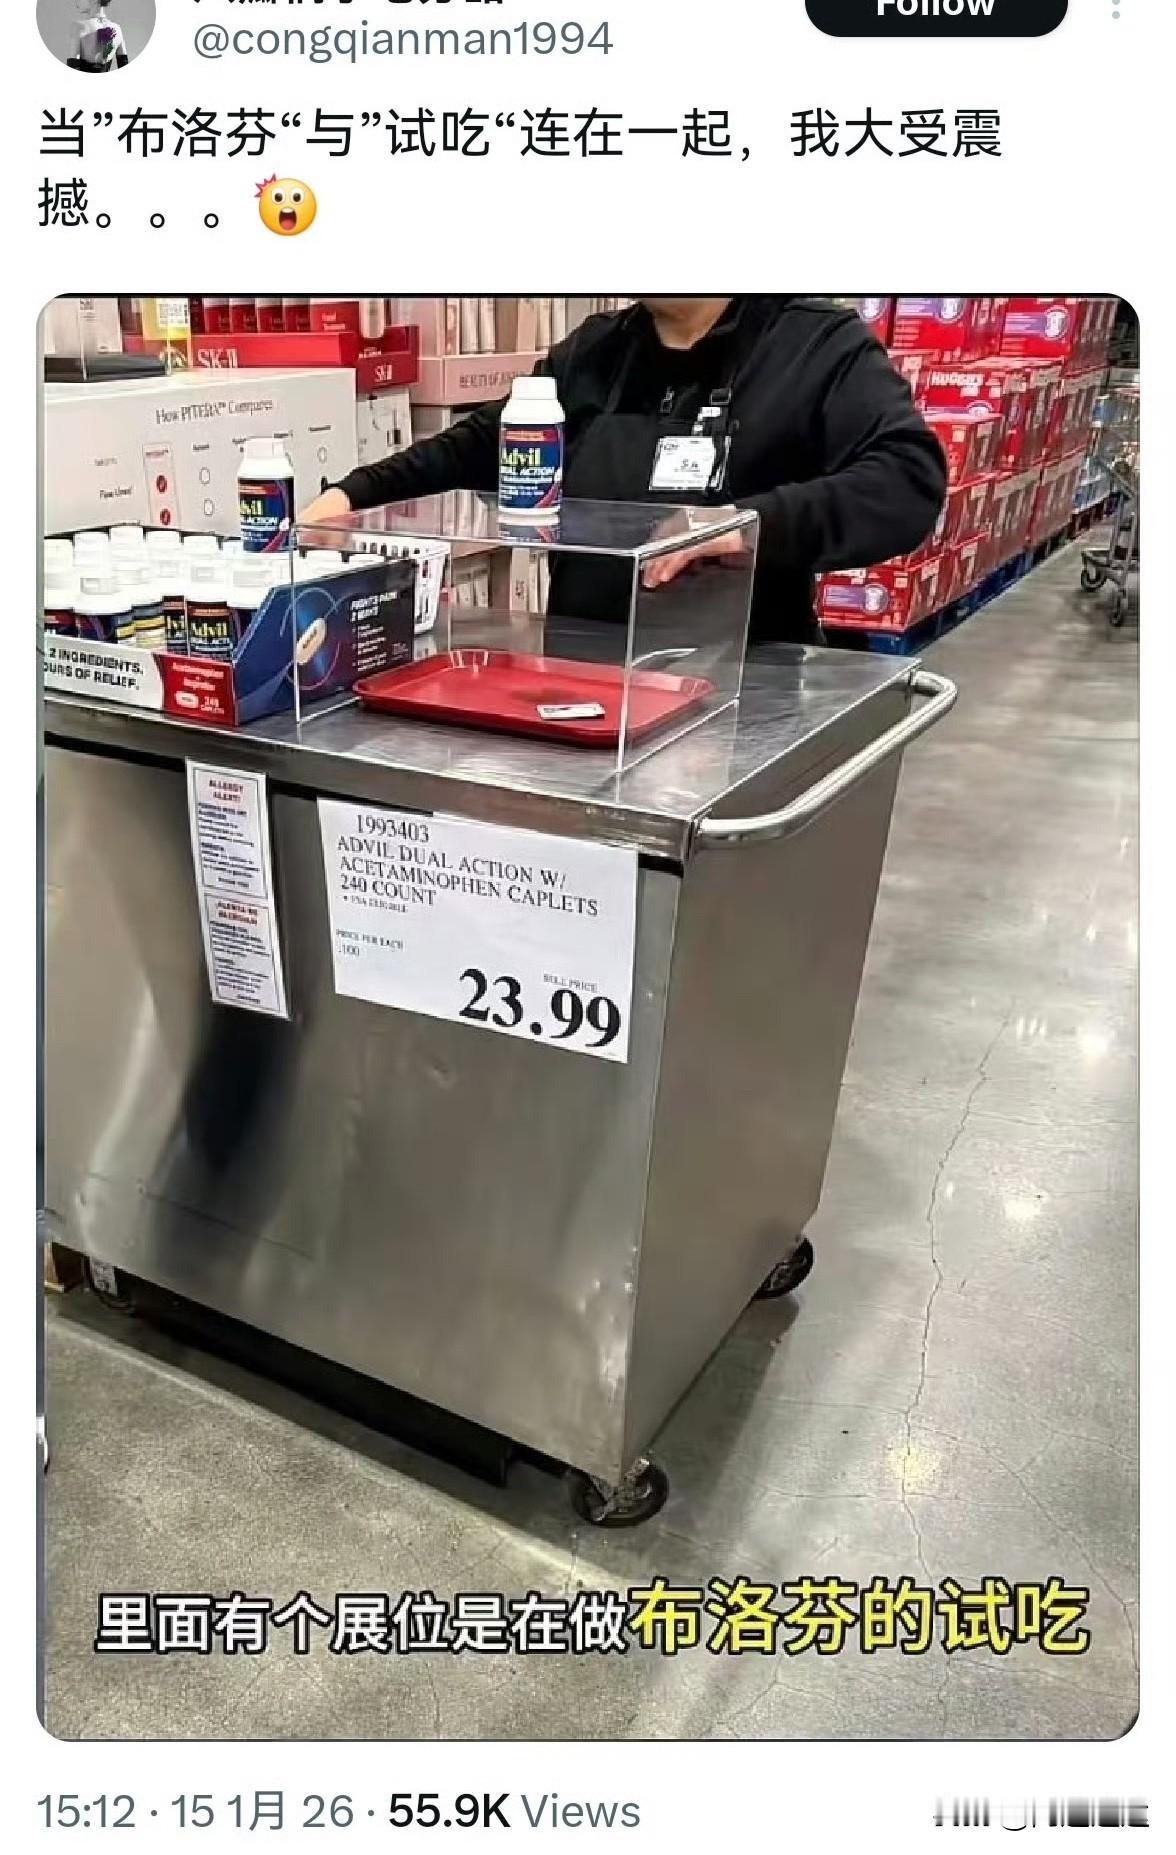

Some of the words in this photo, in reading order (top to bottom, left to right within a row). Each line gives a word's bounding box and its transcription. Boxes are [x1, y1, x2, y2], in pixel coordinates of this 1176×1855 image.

[50, 647, 57, 658] 2
[75, 667, 92, 680] OF
[357, 814, 430, 843] 1993403
[338, 836, 395, 859] ADVIL
[399, 845, 454, 870] DUAL
[458, 857, 533, 883] ACTION
[539, 869, 568, 891] W/
[340, 856, 503, 898] ACETAMINOPHEN
[507, 884, 599, 917] CAPLETS
[341, 873, 368, 893] 240
[371, 879, 437, 906] COUNT
[458, 968, 621, 1048] 23.99
